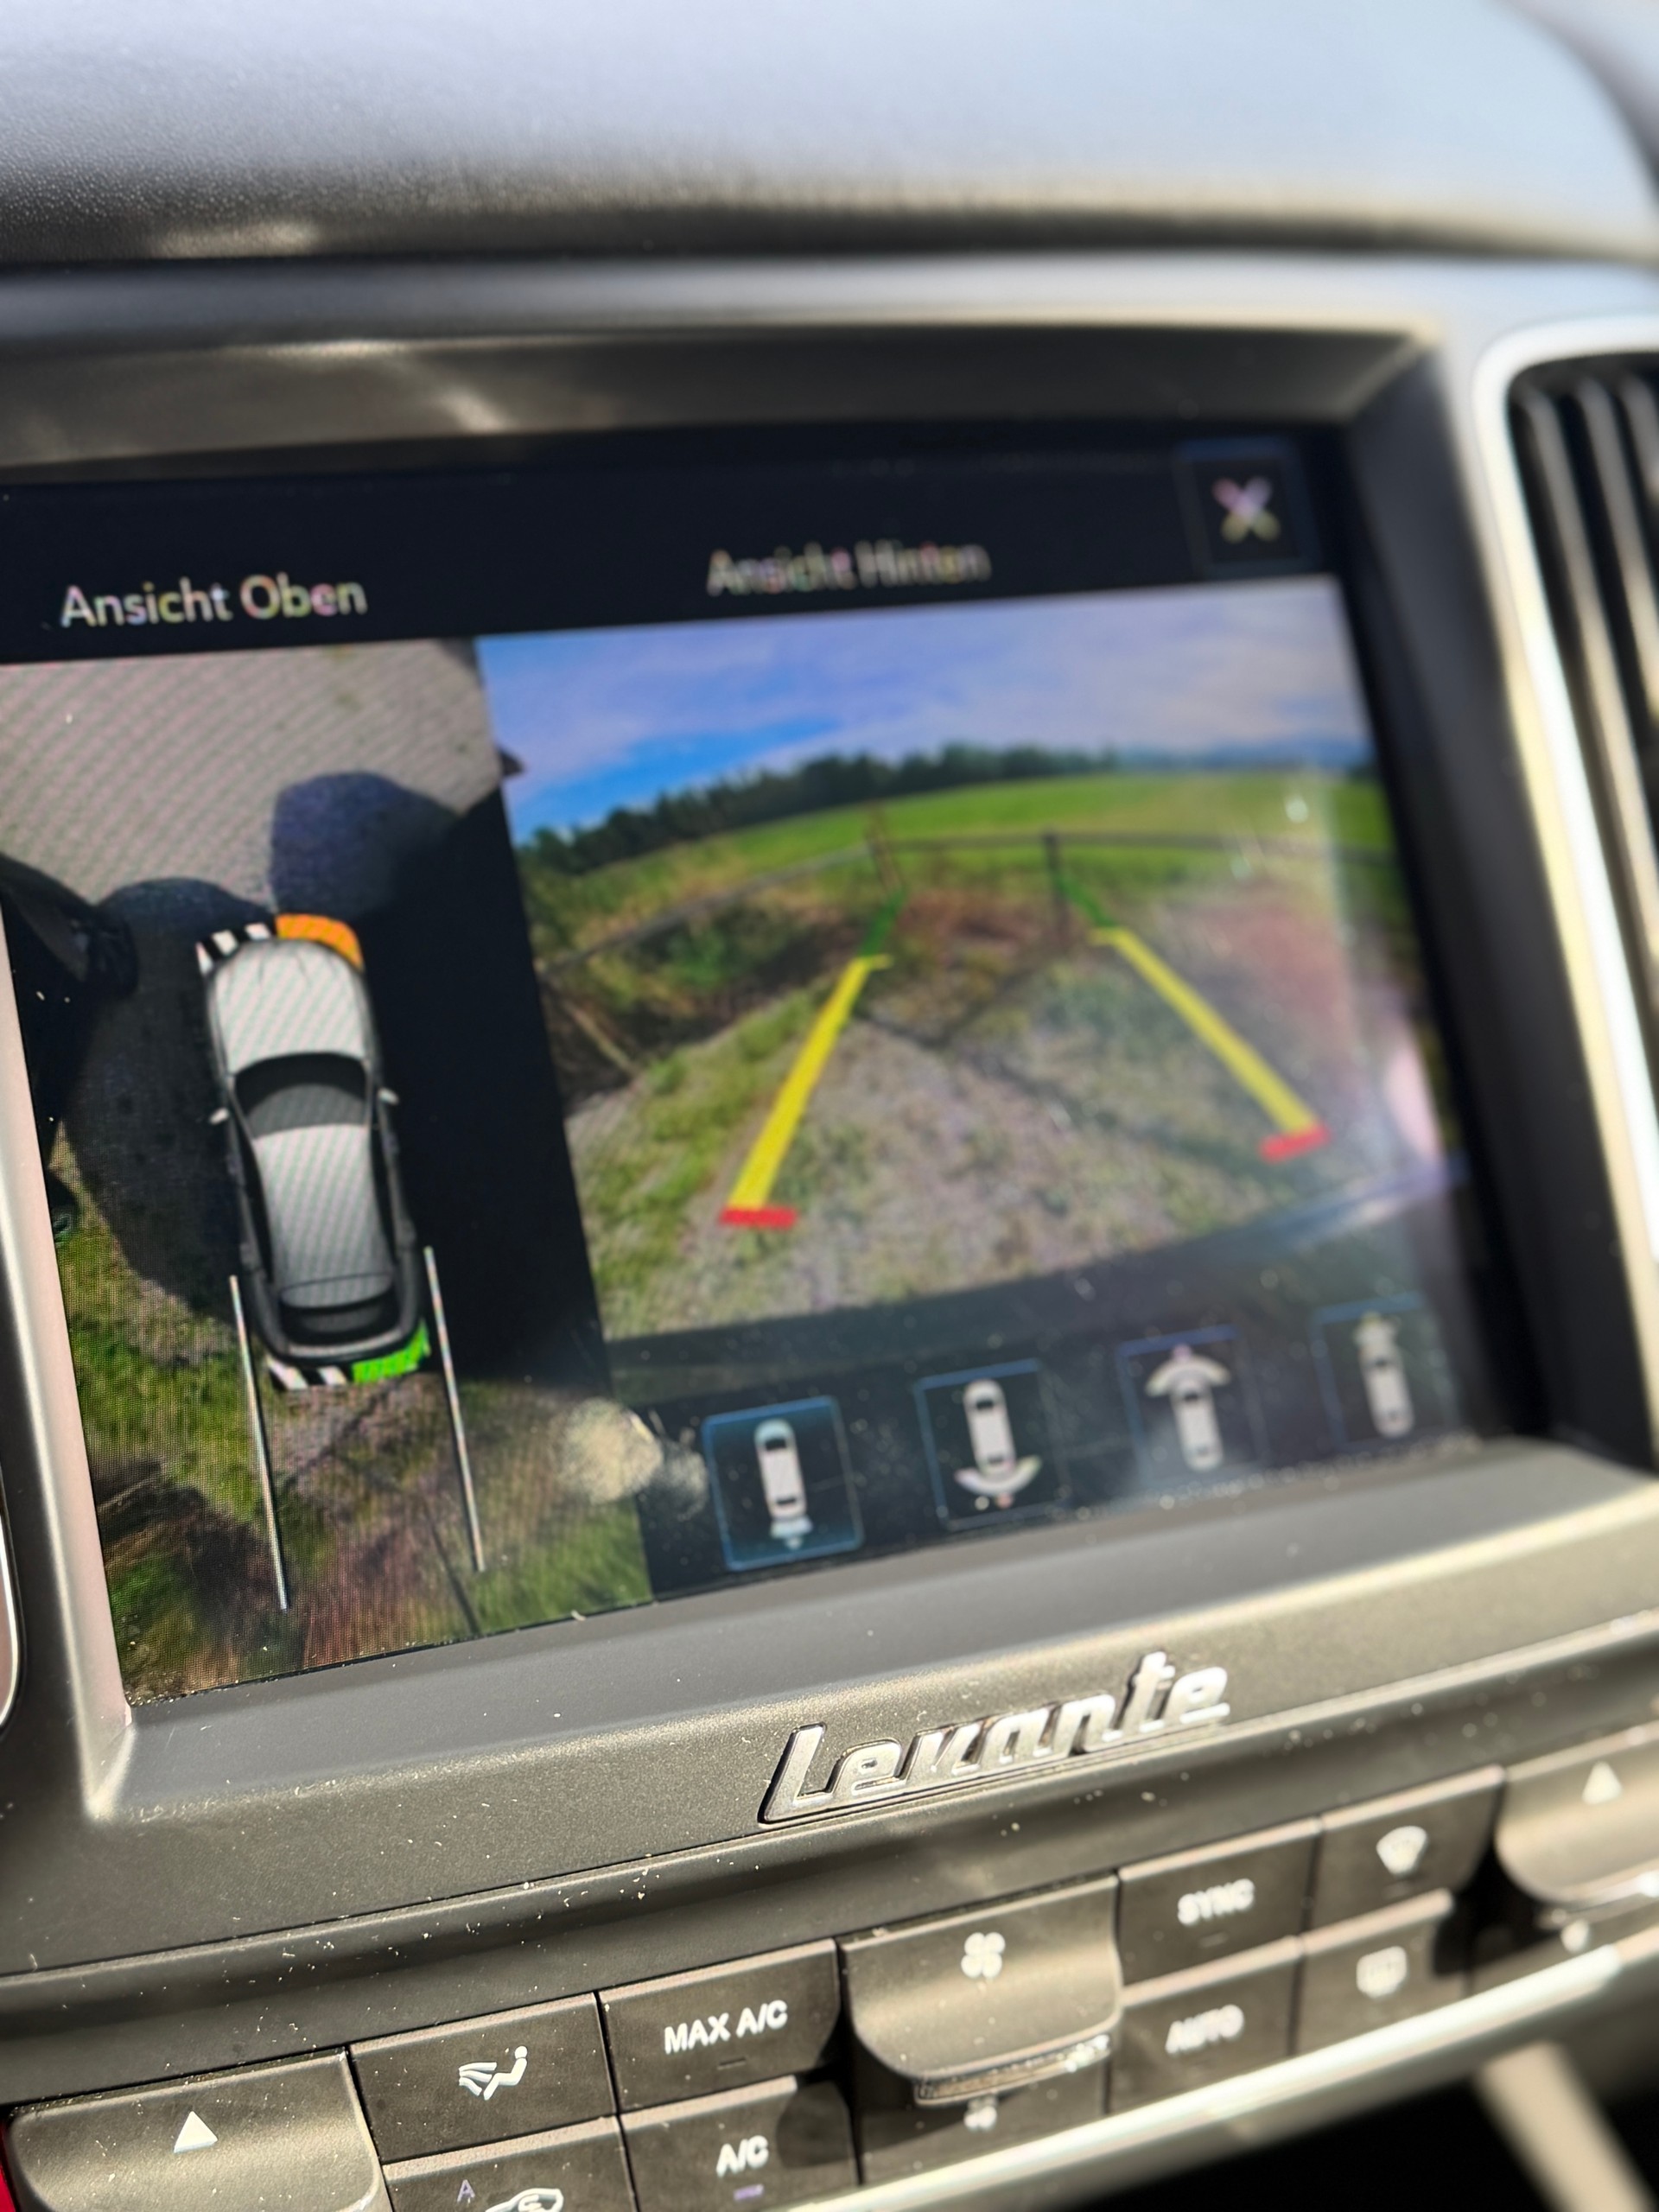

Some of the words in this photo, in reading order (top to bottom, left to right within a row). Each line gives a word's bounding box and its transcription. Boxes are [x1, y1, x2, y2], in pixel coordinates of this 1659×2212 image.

[708, 543, 857, 596] Ansicht
[60, 576, 233, 628] Ansicht
[240, 571, 368, 620] Oben
[759, 1650, 1230, 1827] Levante
[1177, 1878, 1255, 1927] SYNC
[664, 2012, 729, 2055] MAX
[736, 1999, 788, 2037] A/C
[715, 2135, 769, 2177] A/C
[456, 2179, 476, 2202] A
